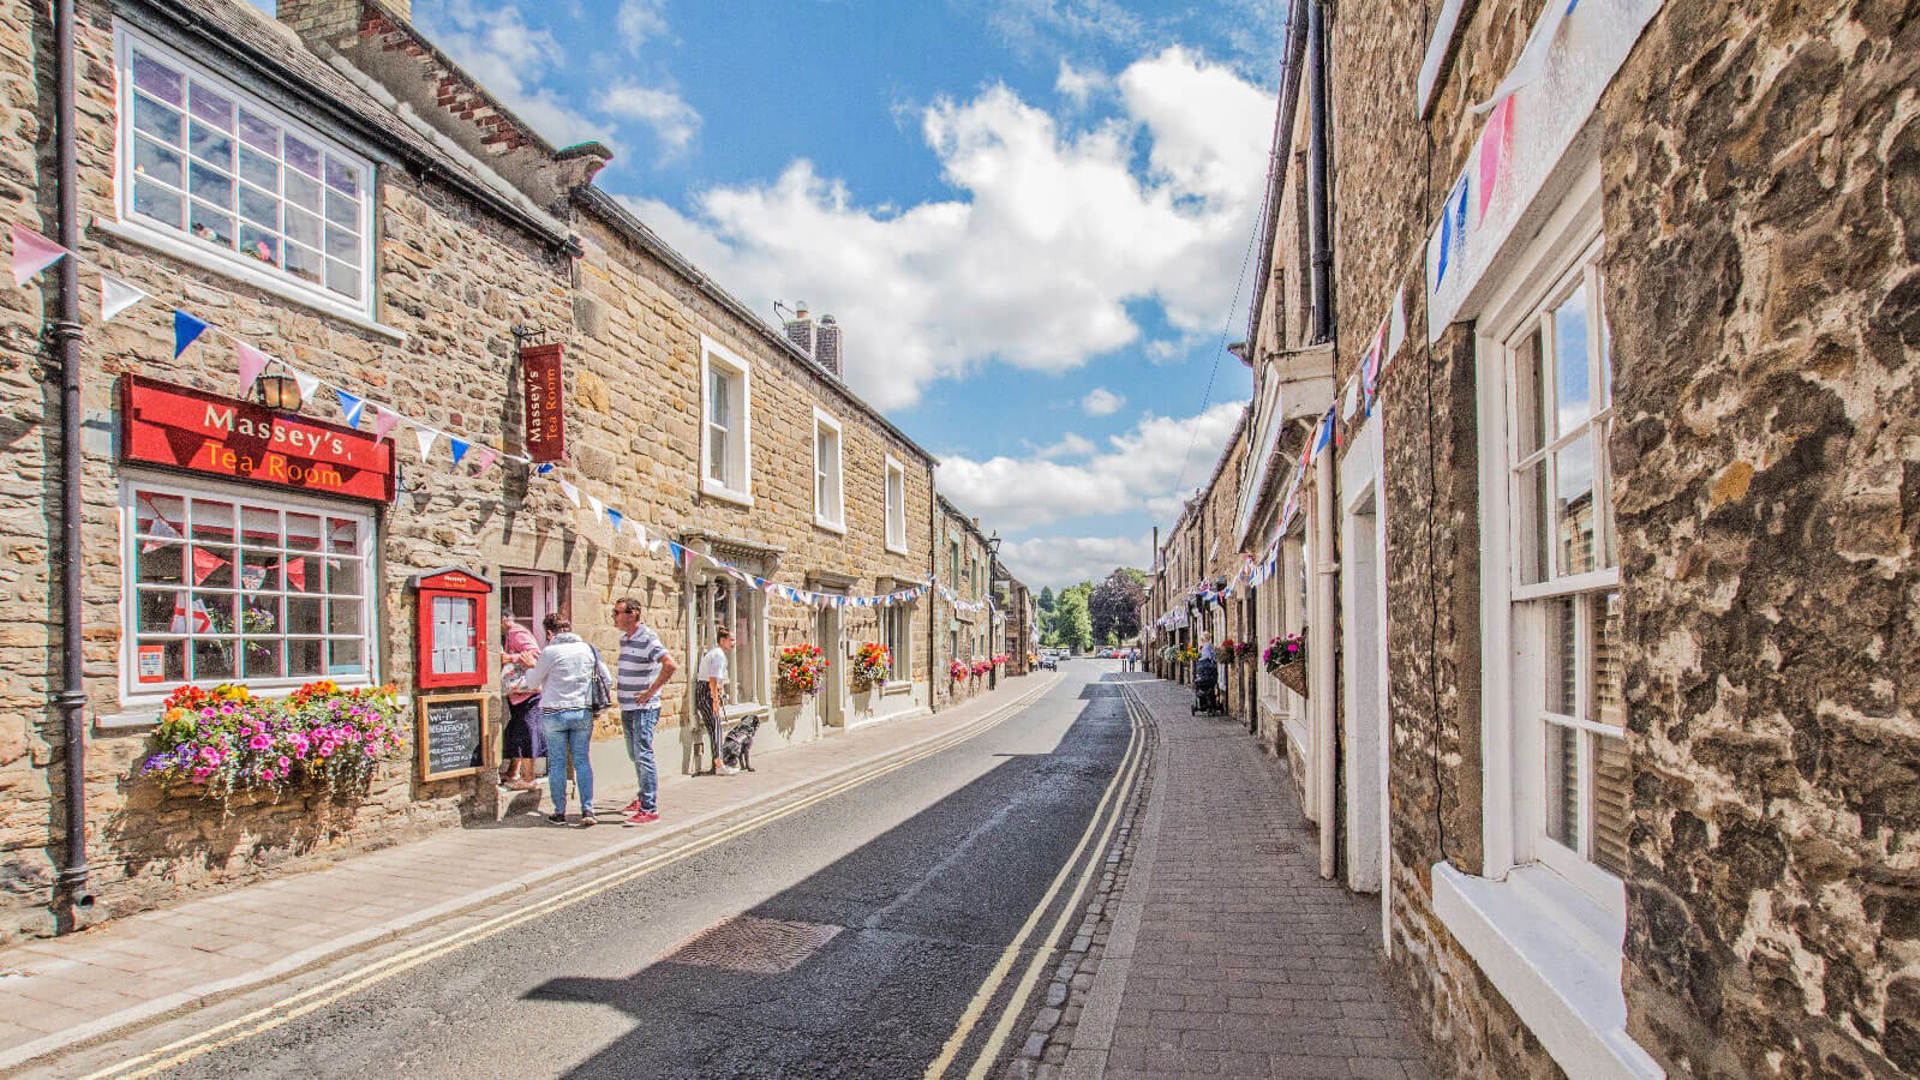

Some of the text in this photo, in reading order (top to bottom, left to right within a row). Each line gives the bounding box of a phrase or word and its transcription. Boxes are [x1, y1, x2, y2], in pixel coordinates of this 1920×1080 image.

[204, 404, 343, 456] Massey's
[528, 371, 543, 442] Massey's
[544, 368, 558, 441] Tea Room
[204, 443, 342, 487] Tea Room
